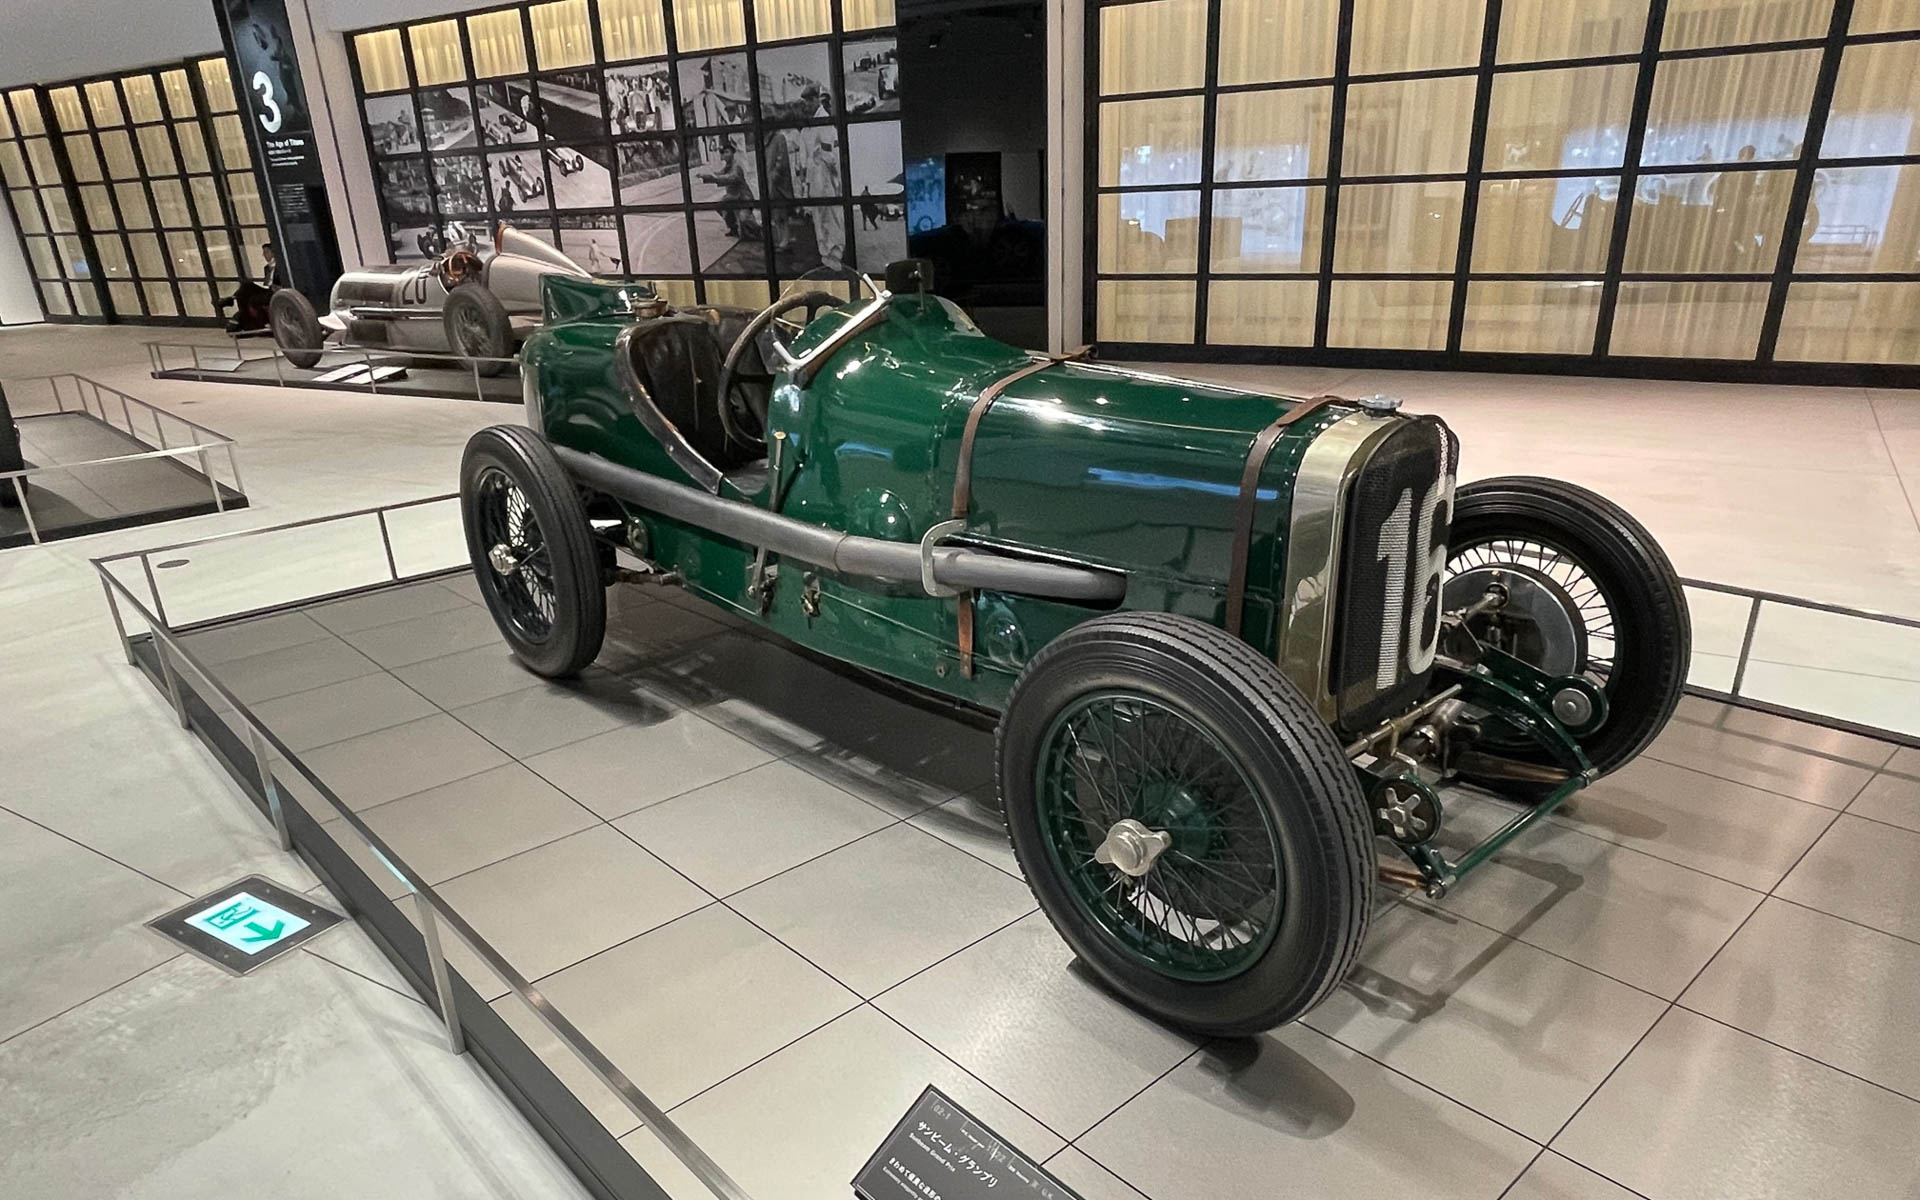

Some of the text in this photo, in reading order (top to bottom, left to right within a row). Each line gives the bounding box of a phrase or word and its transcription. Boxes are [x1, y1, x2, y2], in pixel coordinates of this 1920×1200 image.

[252, 70, 282, 134] 3
[1376, 476, 1456, 690] 16
[917, 1120, 998, 1188] サンビーム・グランプリ
